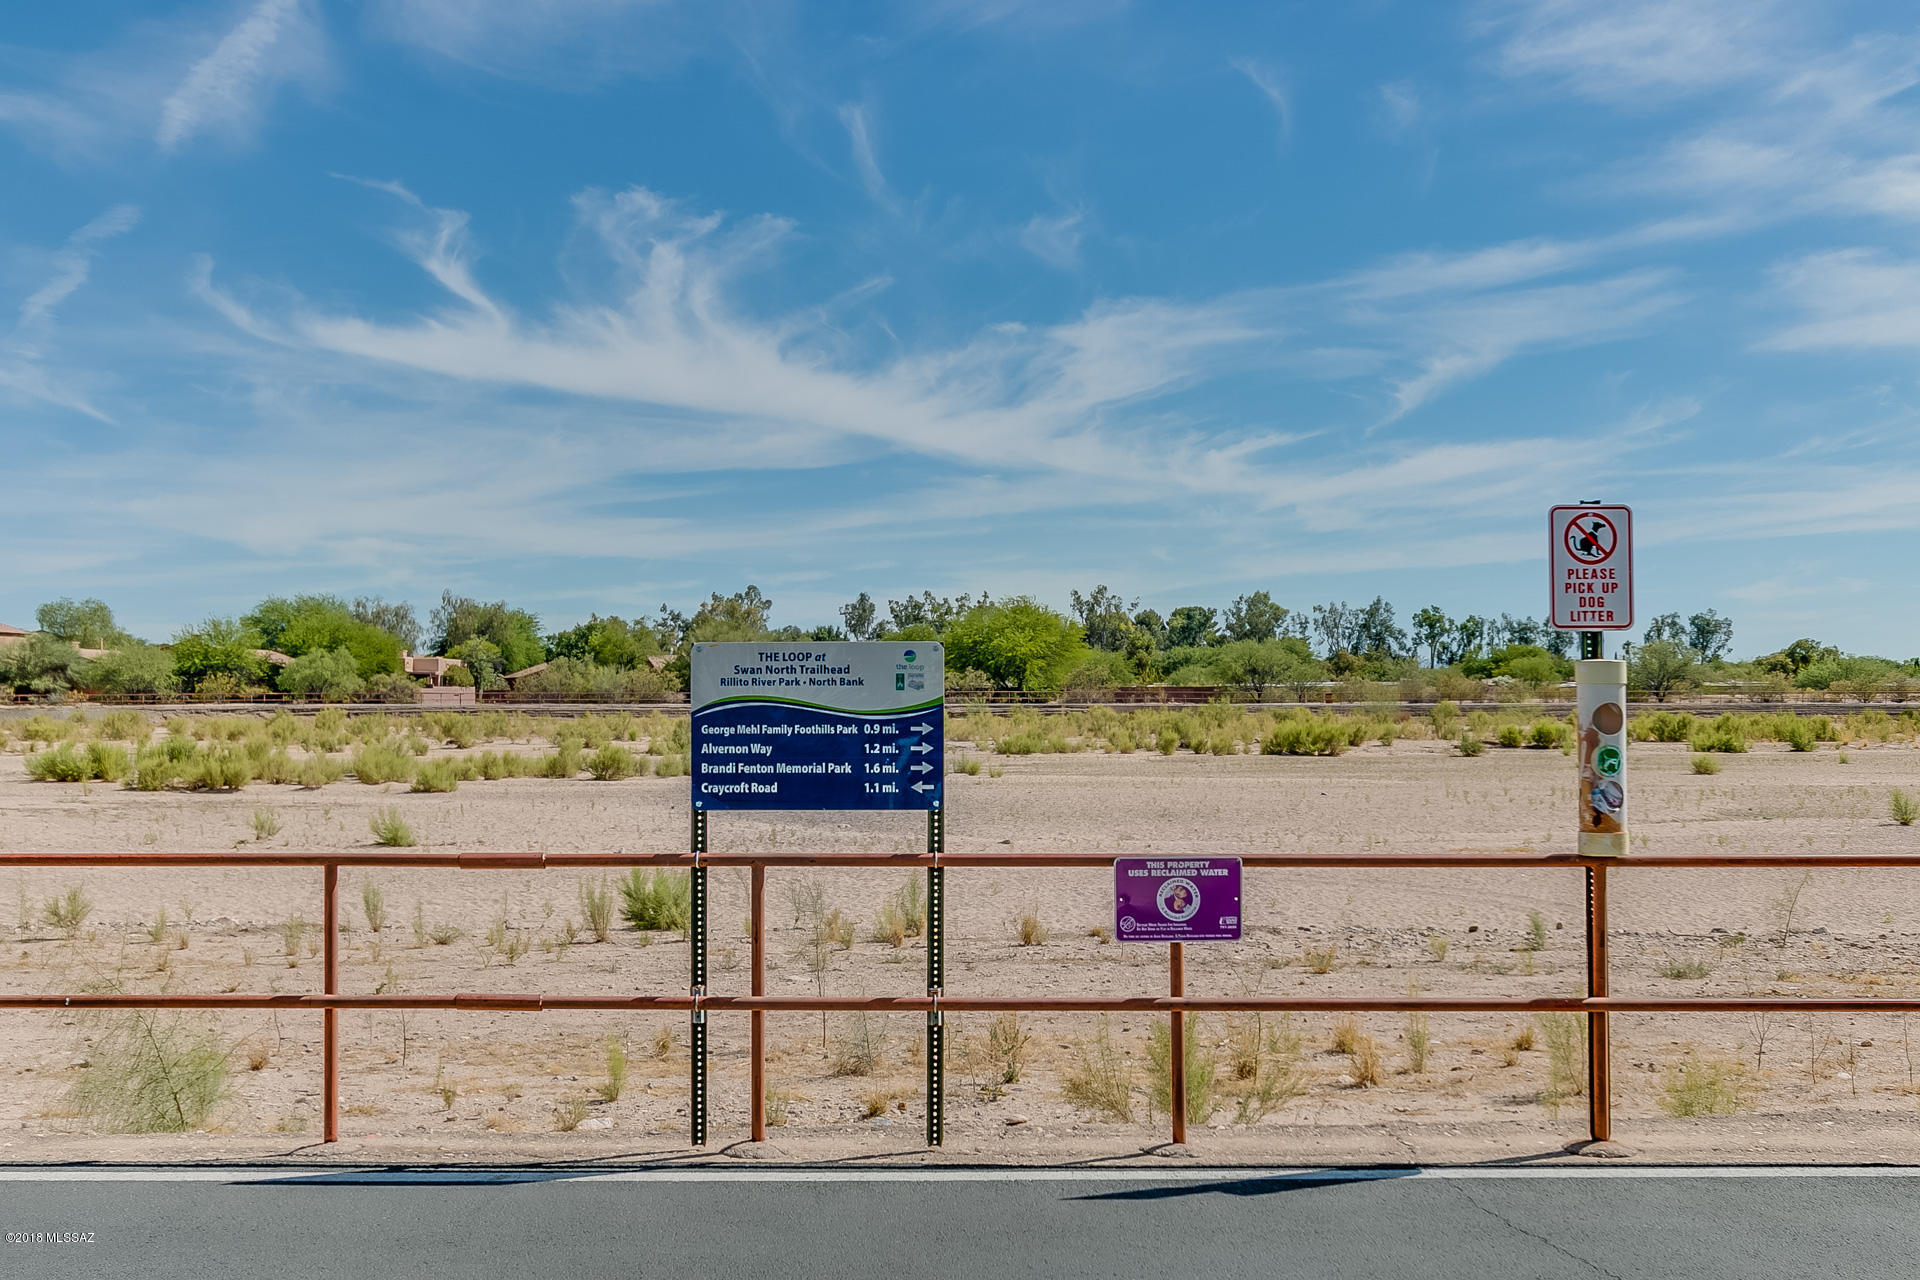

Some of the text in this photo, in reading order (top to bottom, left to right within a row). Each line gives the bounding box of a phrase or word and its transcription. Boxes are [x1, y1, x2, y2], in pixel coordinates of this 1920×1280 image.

[1567, 568, 1615, 580] PLEASE
[1565, 582, 1618, 594] PICK UP
[1579, 596, 1605, 608] DOG
[1570, 610, 1614, 622] LITTER
[758, 652, 826, 662] THE LOOP at
[734, 664, 850, 675] Swan North Trailhead
[720, 677, 865, 687] Rillito River Park North Bank
[701, 723, 899, 737] George Mehl Family Foothills Park 0.9 mi.
[701, 742, 899, 757] Alvernon Way 1.2 mi.
[701, 762, 899, 774] Brandi Fenton Memorial Park 1.6 mi.
[701, 781, 899, 796] Craycroft Road 1.1 mi.
[1146, 861, 1210, 869] THIS PROPERTY
[1128, 868, 1229, 877] USES RECLAIMED WATER
